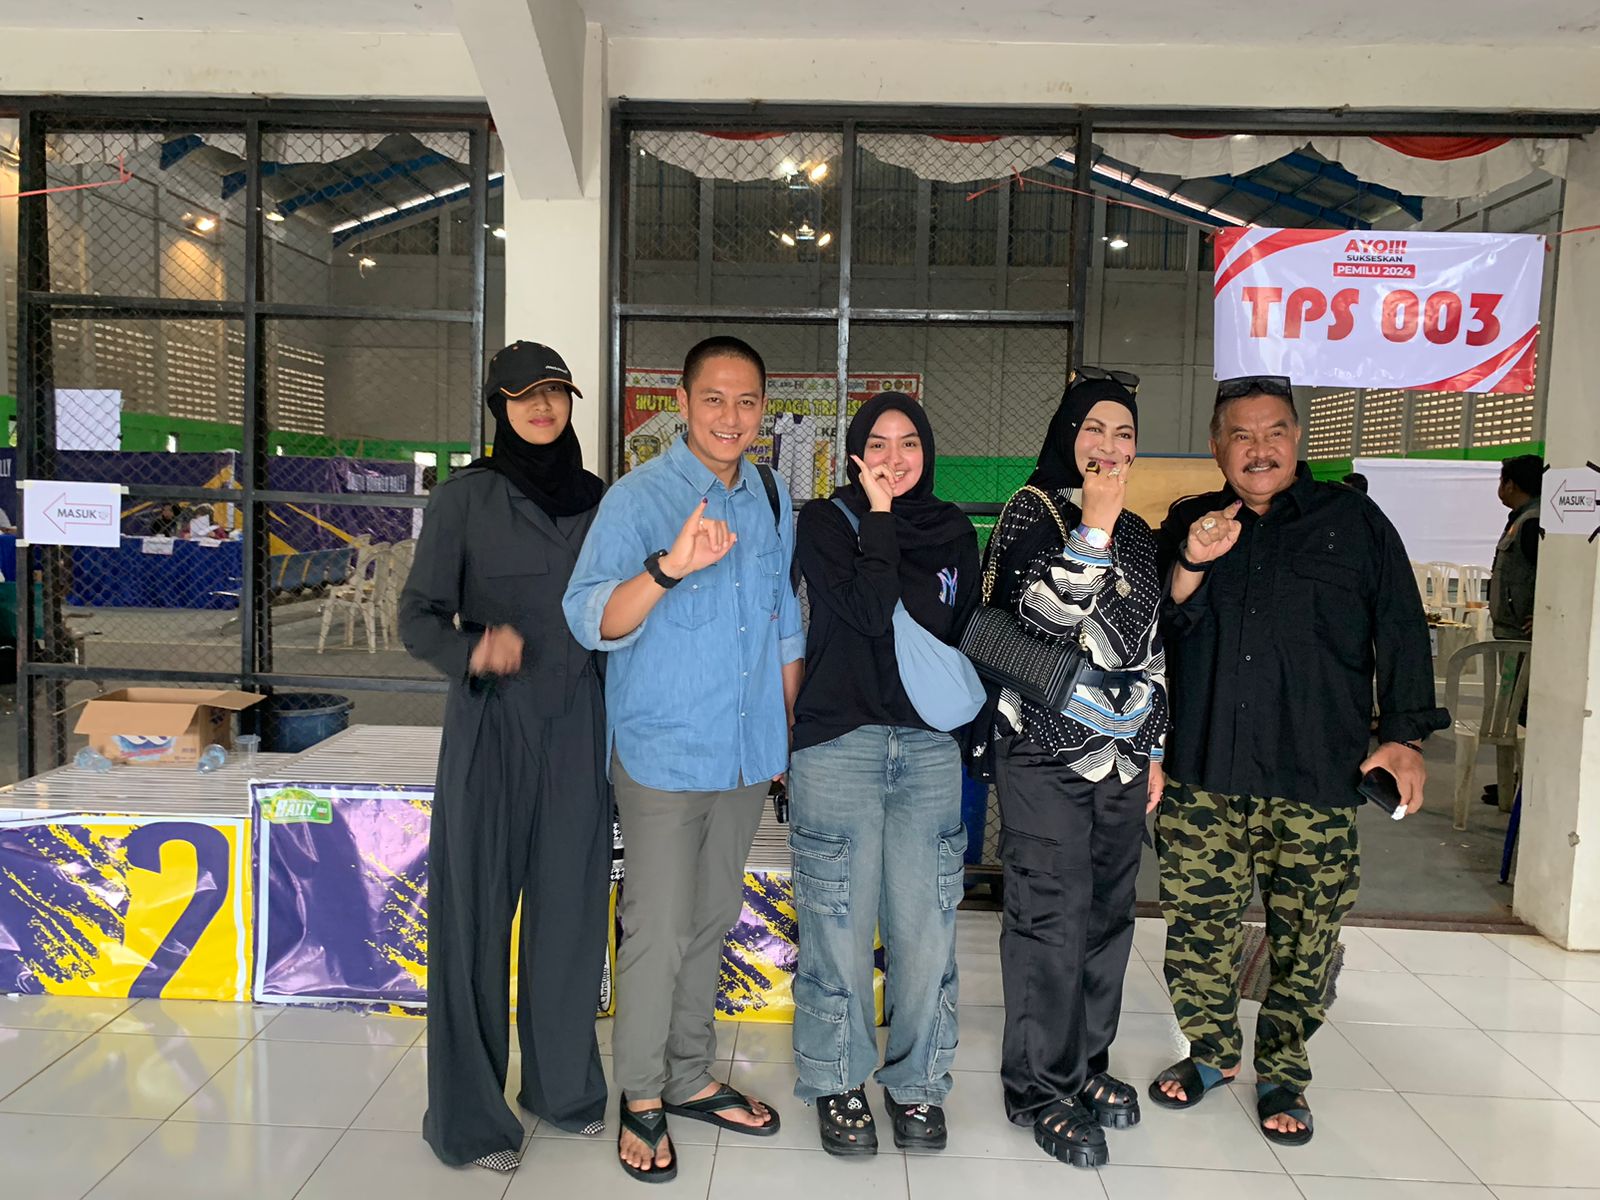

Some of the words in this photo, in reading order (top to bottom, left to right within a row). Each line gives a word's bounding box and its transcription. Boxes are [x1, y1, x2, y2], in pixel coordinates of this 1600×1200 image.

[1344, 239, 1408, 254] AYO!!!
[1346, 254, 1403, 263] SUKSESKAN
[1337, 265, 1380, 275] PEMILU
[1382, 266, 1412, 276] 2024
[1241, 286, 1360, 341] TPS
[1381, 289, 1504, 347] 003
[1558, 495, 1586, 506] MASUK
[56, 508, 98, 520] MASUK
